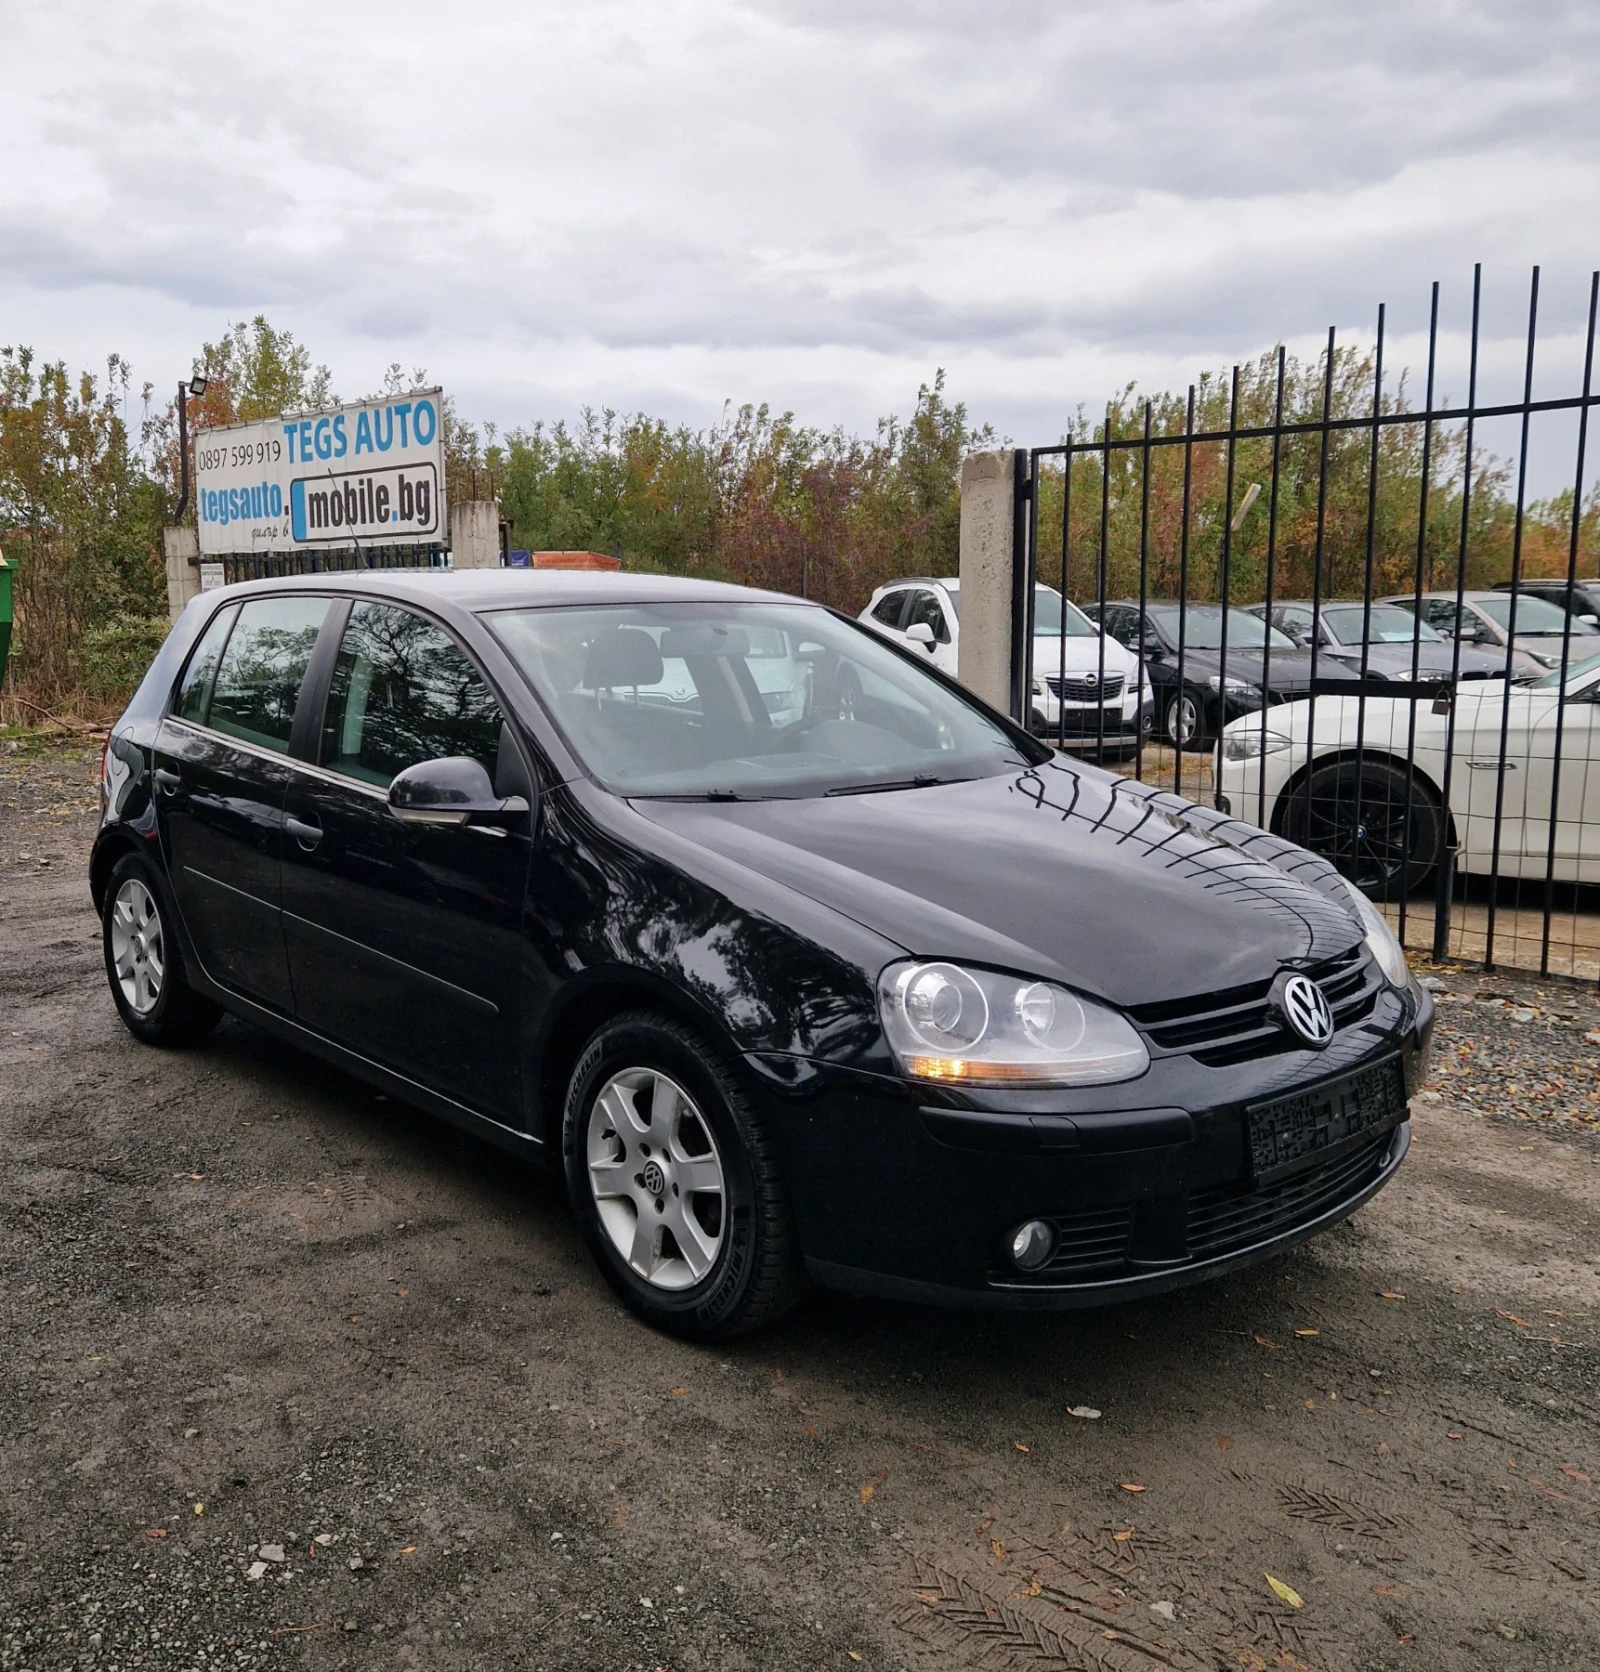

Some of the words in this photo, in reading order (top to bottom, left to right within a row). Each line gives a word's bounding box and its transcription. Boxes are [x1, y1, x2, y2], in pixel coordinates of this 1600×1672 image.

[199, 447, 227, 471] 0897
[232, 444, 253, 467] 599
[256, 440, 281, 463] 919
[283, 414, 347, 464] TEGS
[355, 400, 436, 455] AUTO
[308, 474, 430, 528] mobile.bg
[567, 1044, 602, 1117] MICHELIN
[700, 1249, 743, 1319] MICHELIN
